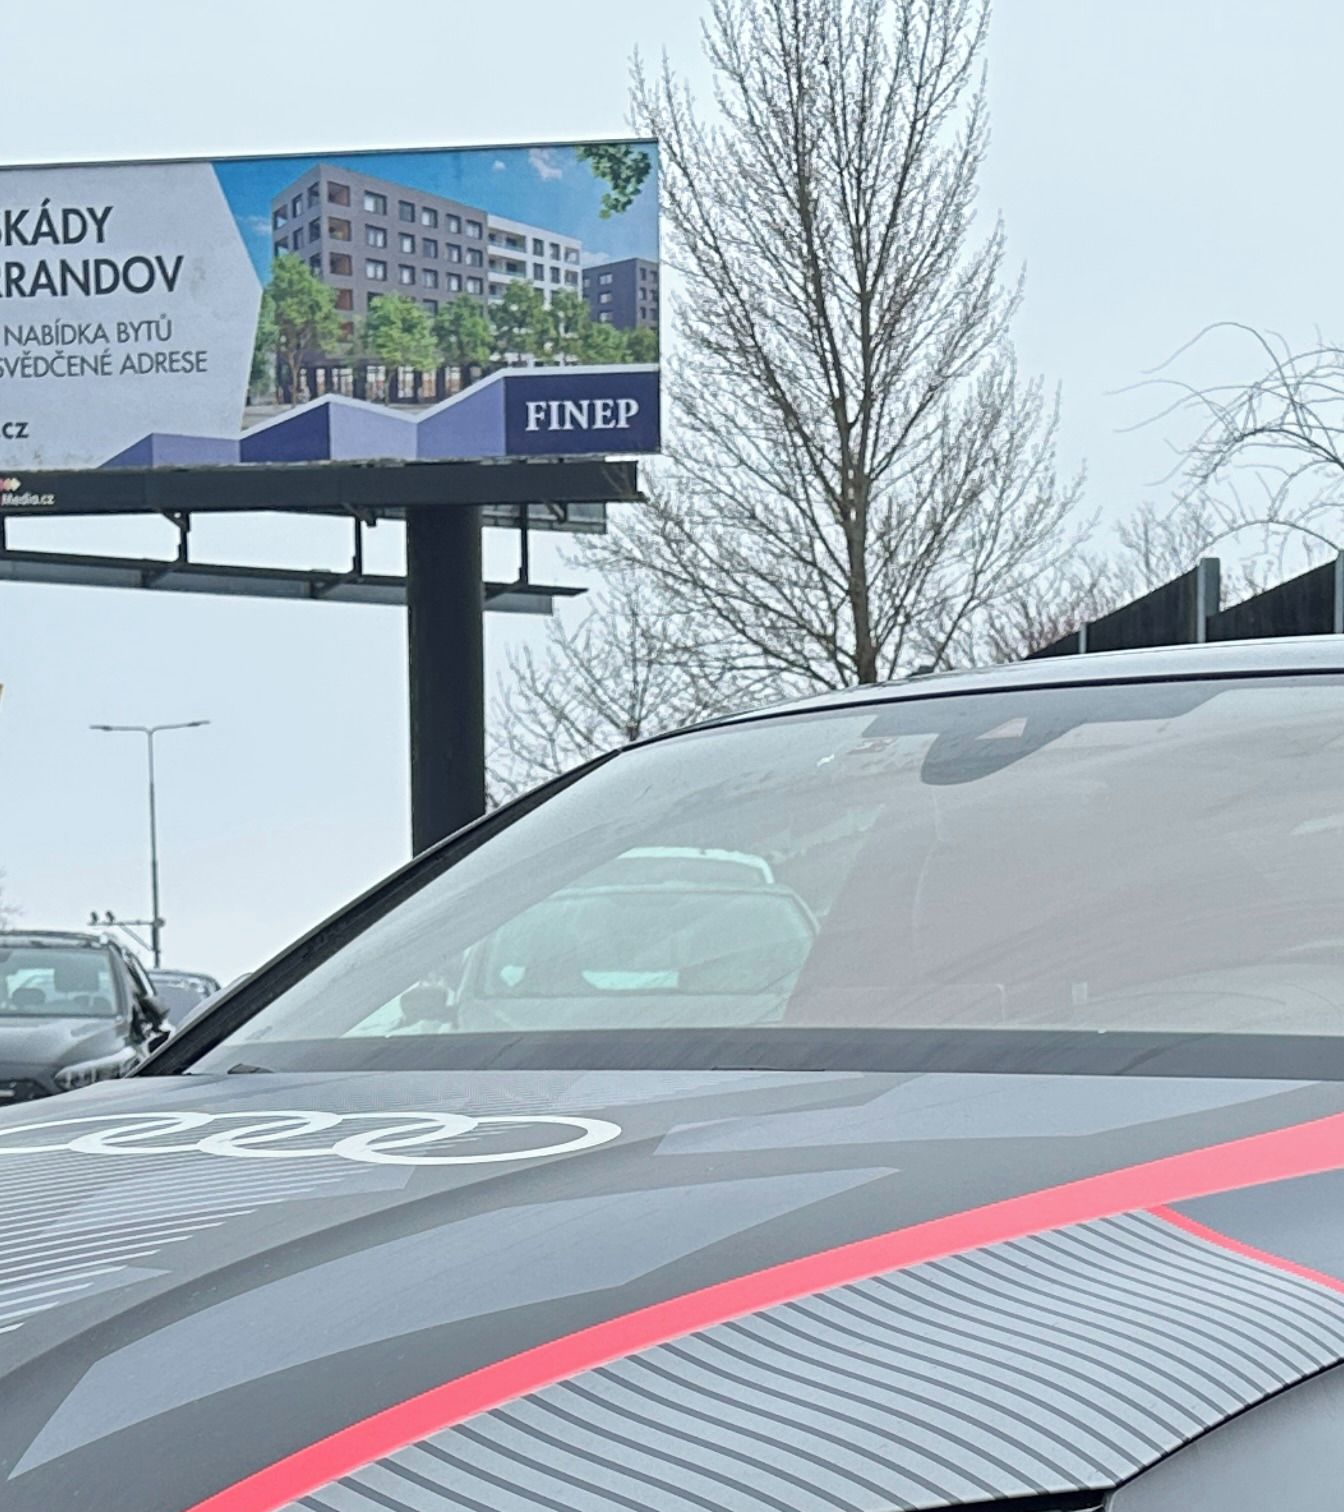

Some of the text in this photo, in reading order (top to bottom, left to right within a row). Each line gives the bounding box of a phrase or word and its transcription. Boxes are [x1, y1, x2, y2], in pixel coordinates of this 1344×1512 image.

[4, 318, 110, 347] NABÍDKA
[116, 313, 173, 343] BYTŮ
[119, 350, 208, 376] ADRESE
[525, 398, 640, 431] FINEP
